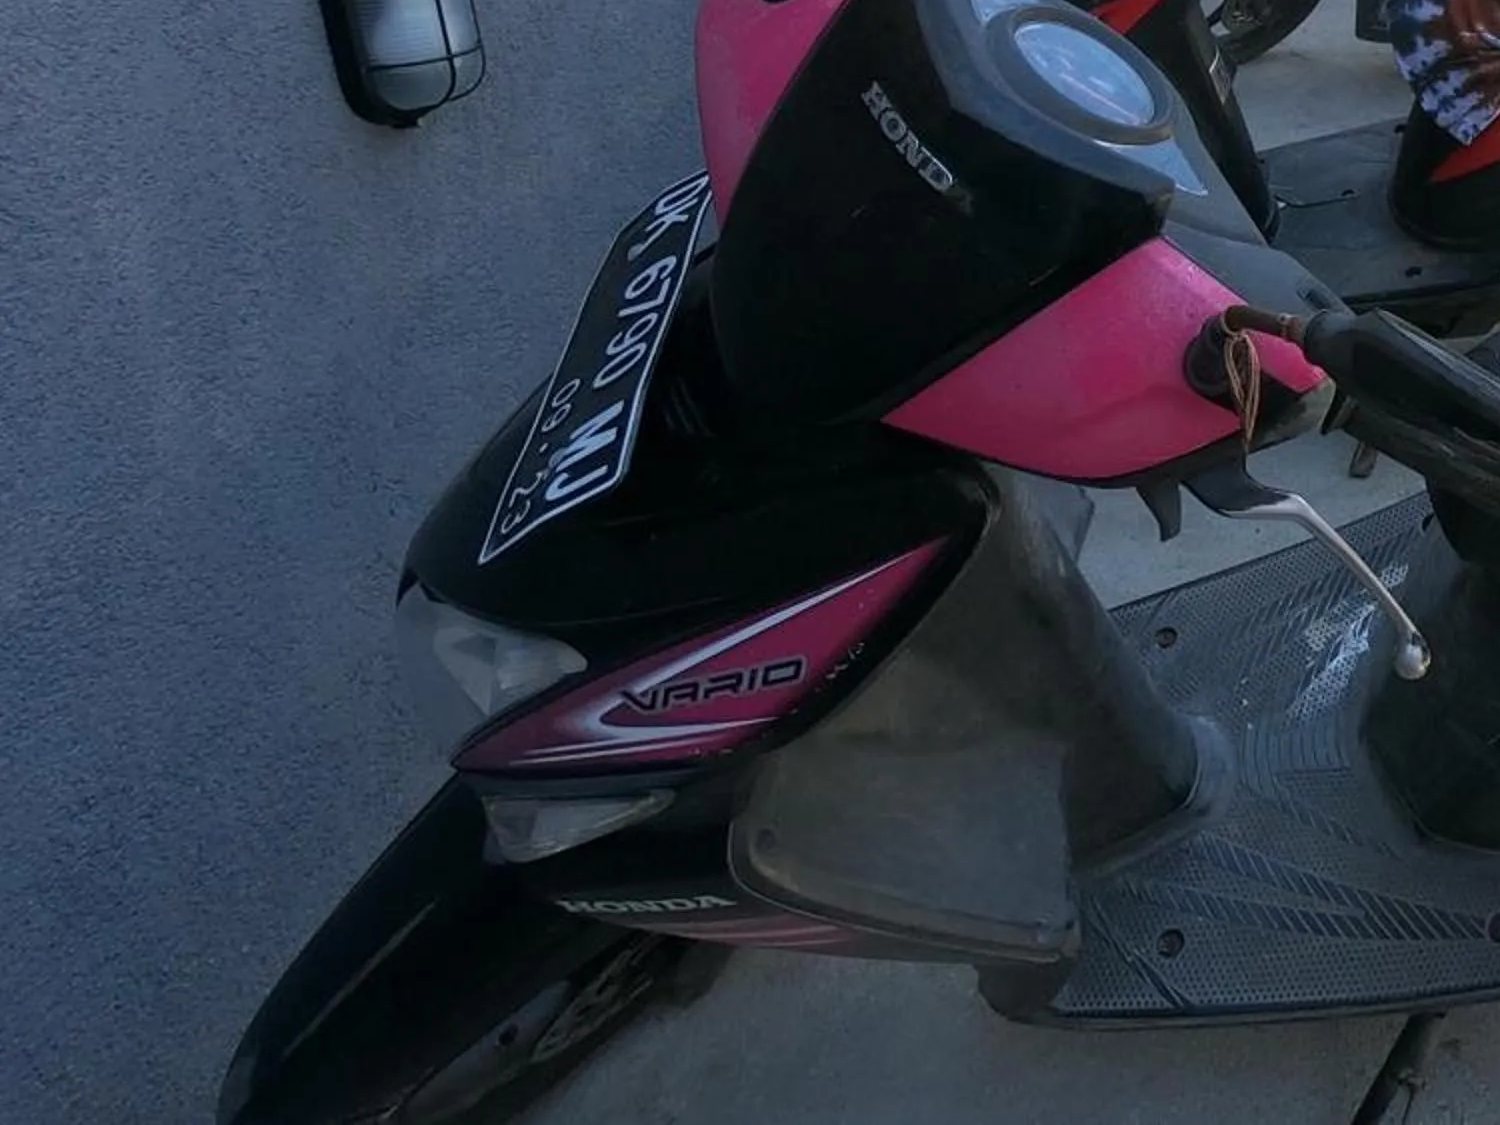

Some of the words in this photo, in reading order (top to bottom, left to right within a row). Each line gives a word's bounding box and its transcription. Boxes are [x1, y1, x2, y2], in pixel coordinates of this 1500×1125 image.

[641, 174, 709, 248] DK
[593, 254, 677, 389] 6790
[545, 399, 625, 492] MJ
[619, 655, 806, 715] VARIO
[555, 895, 737, 913] HONDA
